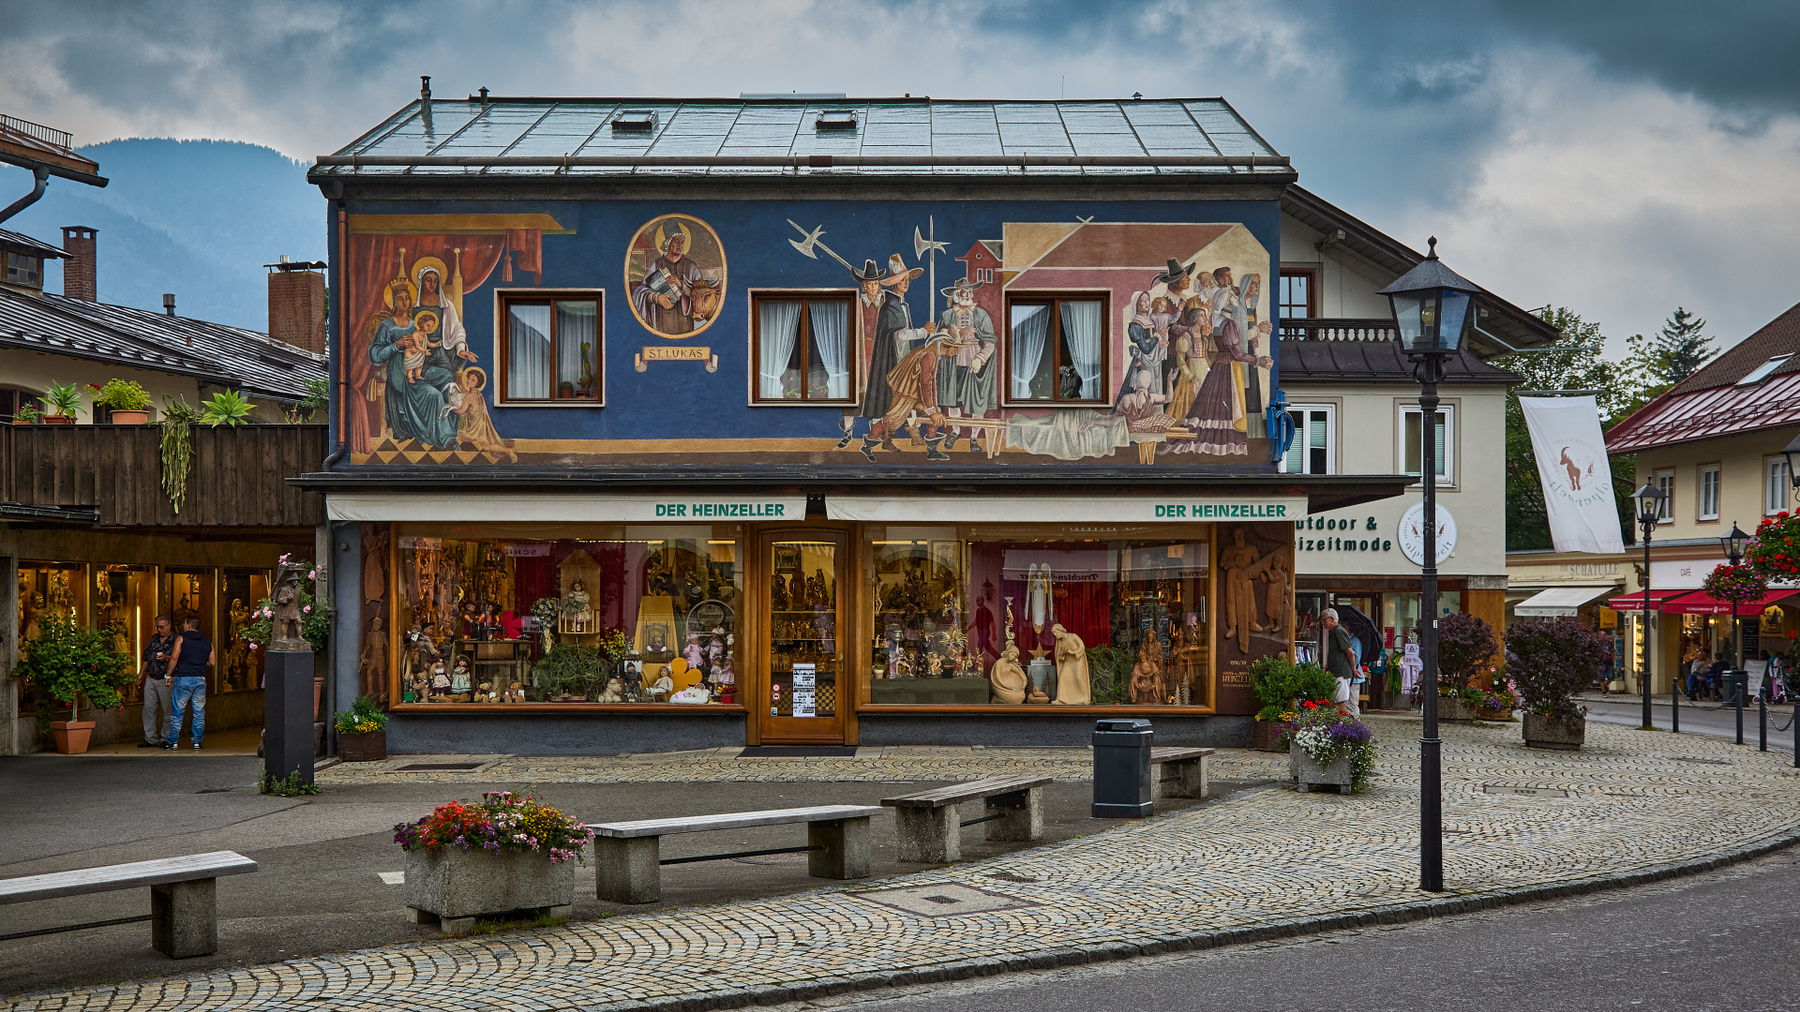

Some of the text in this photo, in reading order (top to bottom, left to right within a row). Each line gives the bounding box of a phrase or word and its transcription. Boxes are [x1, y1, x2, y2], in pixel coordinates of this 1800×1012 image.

[655, 503, 785, 517] DER HEINZELLER
[1155, 504, 1286, 518] DER HEINZELLER
[1296, 516, 1378, 531] utdoor &
[1295, 537, 1392, 552] izeitmode
[1569, 563, 1620, 576] SCHATULLE
[1222, 675, 1249, 683] HEINZEL
